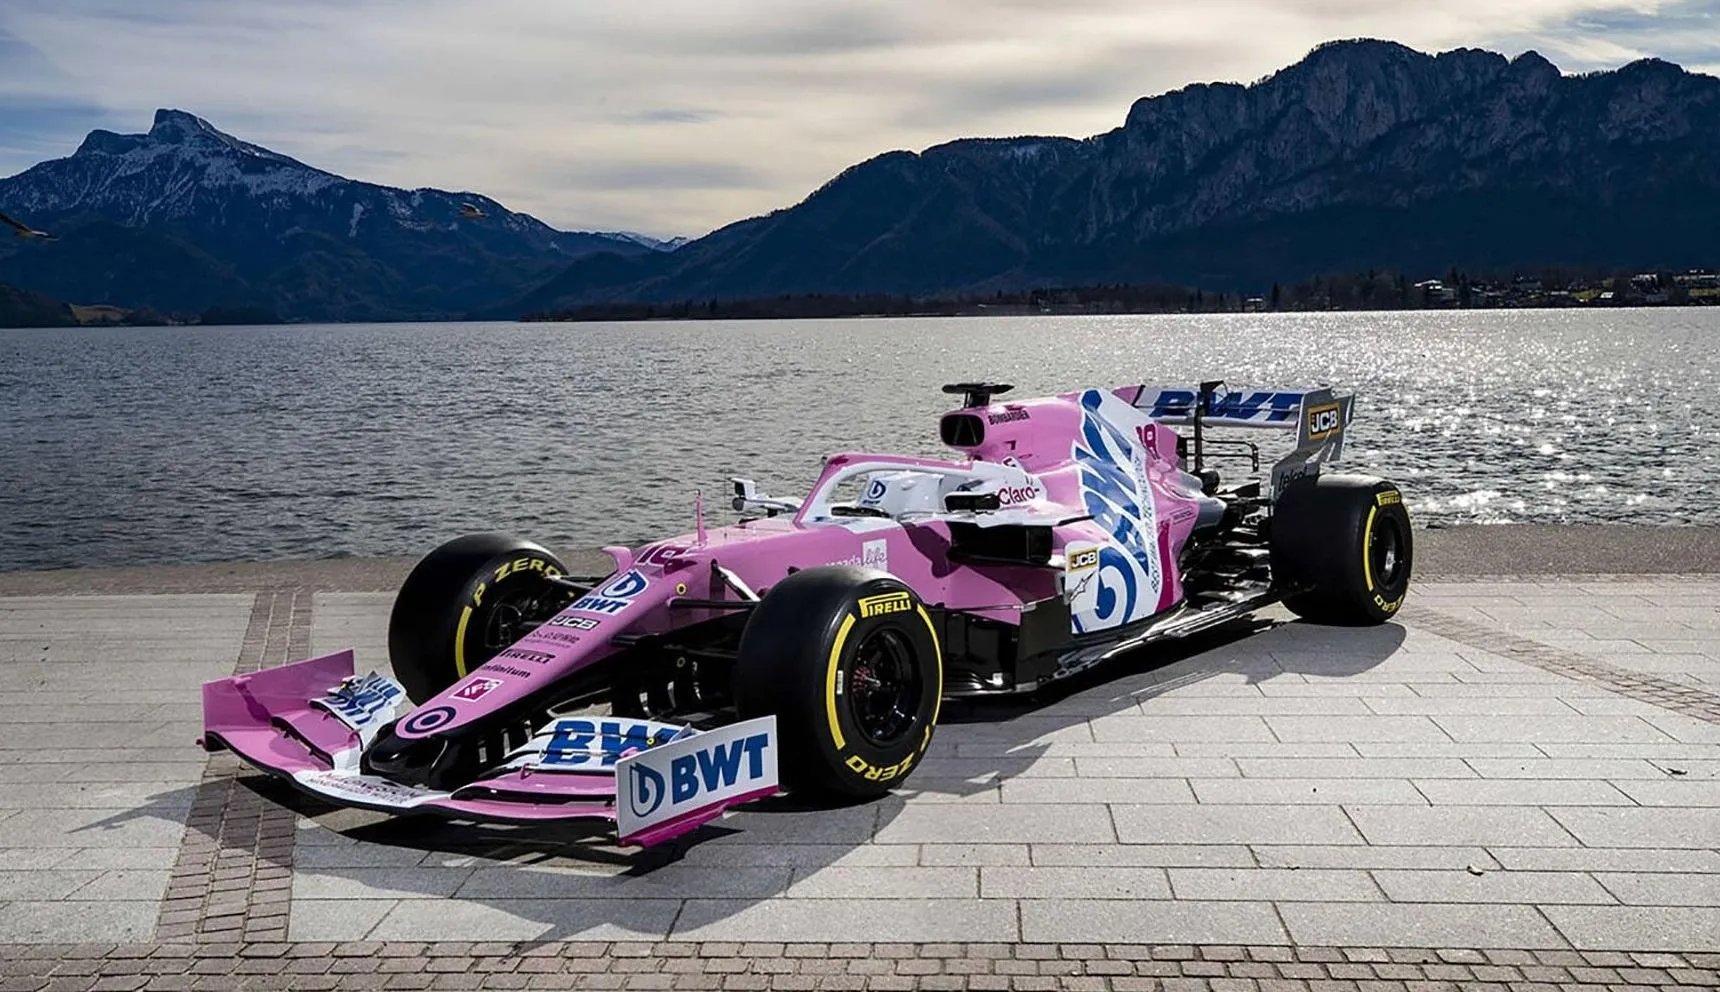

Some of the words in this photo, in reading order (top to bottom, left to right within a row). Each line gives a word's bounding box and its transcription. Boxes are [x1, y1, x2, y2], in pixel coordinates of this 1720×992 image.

[1311, 409, 1338, 434] JCB
[494, 558, 561, 583] ZERO
[1072, 552, 1097, 568] JCB
[572, 597, 629, 613] BWT
[858, 591, 911, 618] PIRELLI
[550, 616, 599, 630] JCB
[542, 720, 681, 766] BW
[671, 733, 769, 805] BWT
[845, 753, 915, 782] ZERO
